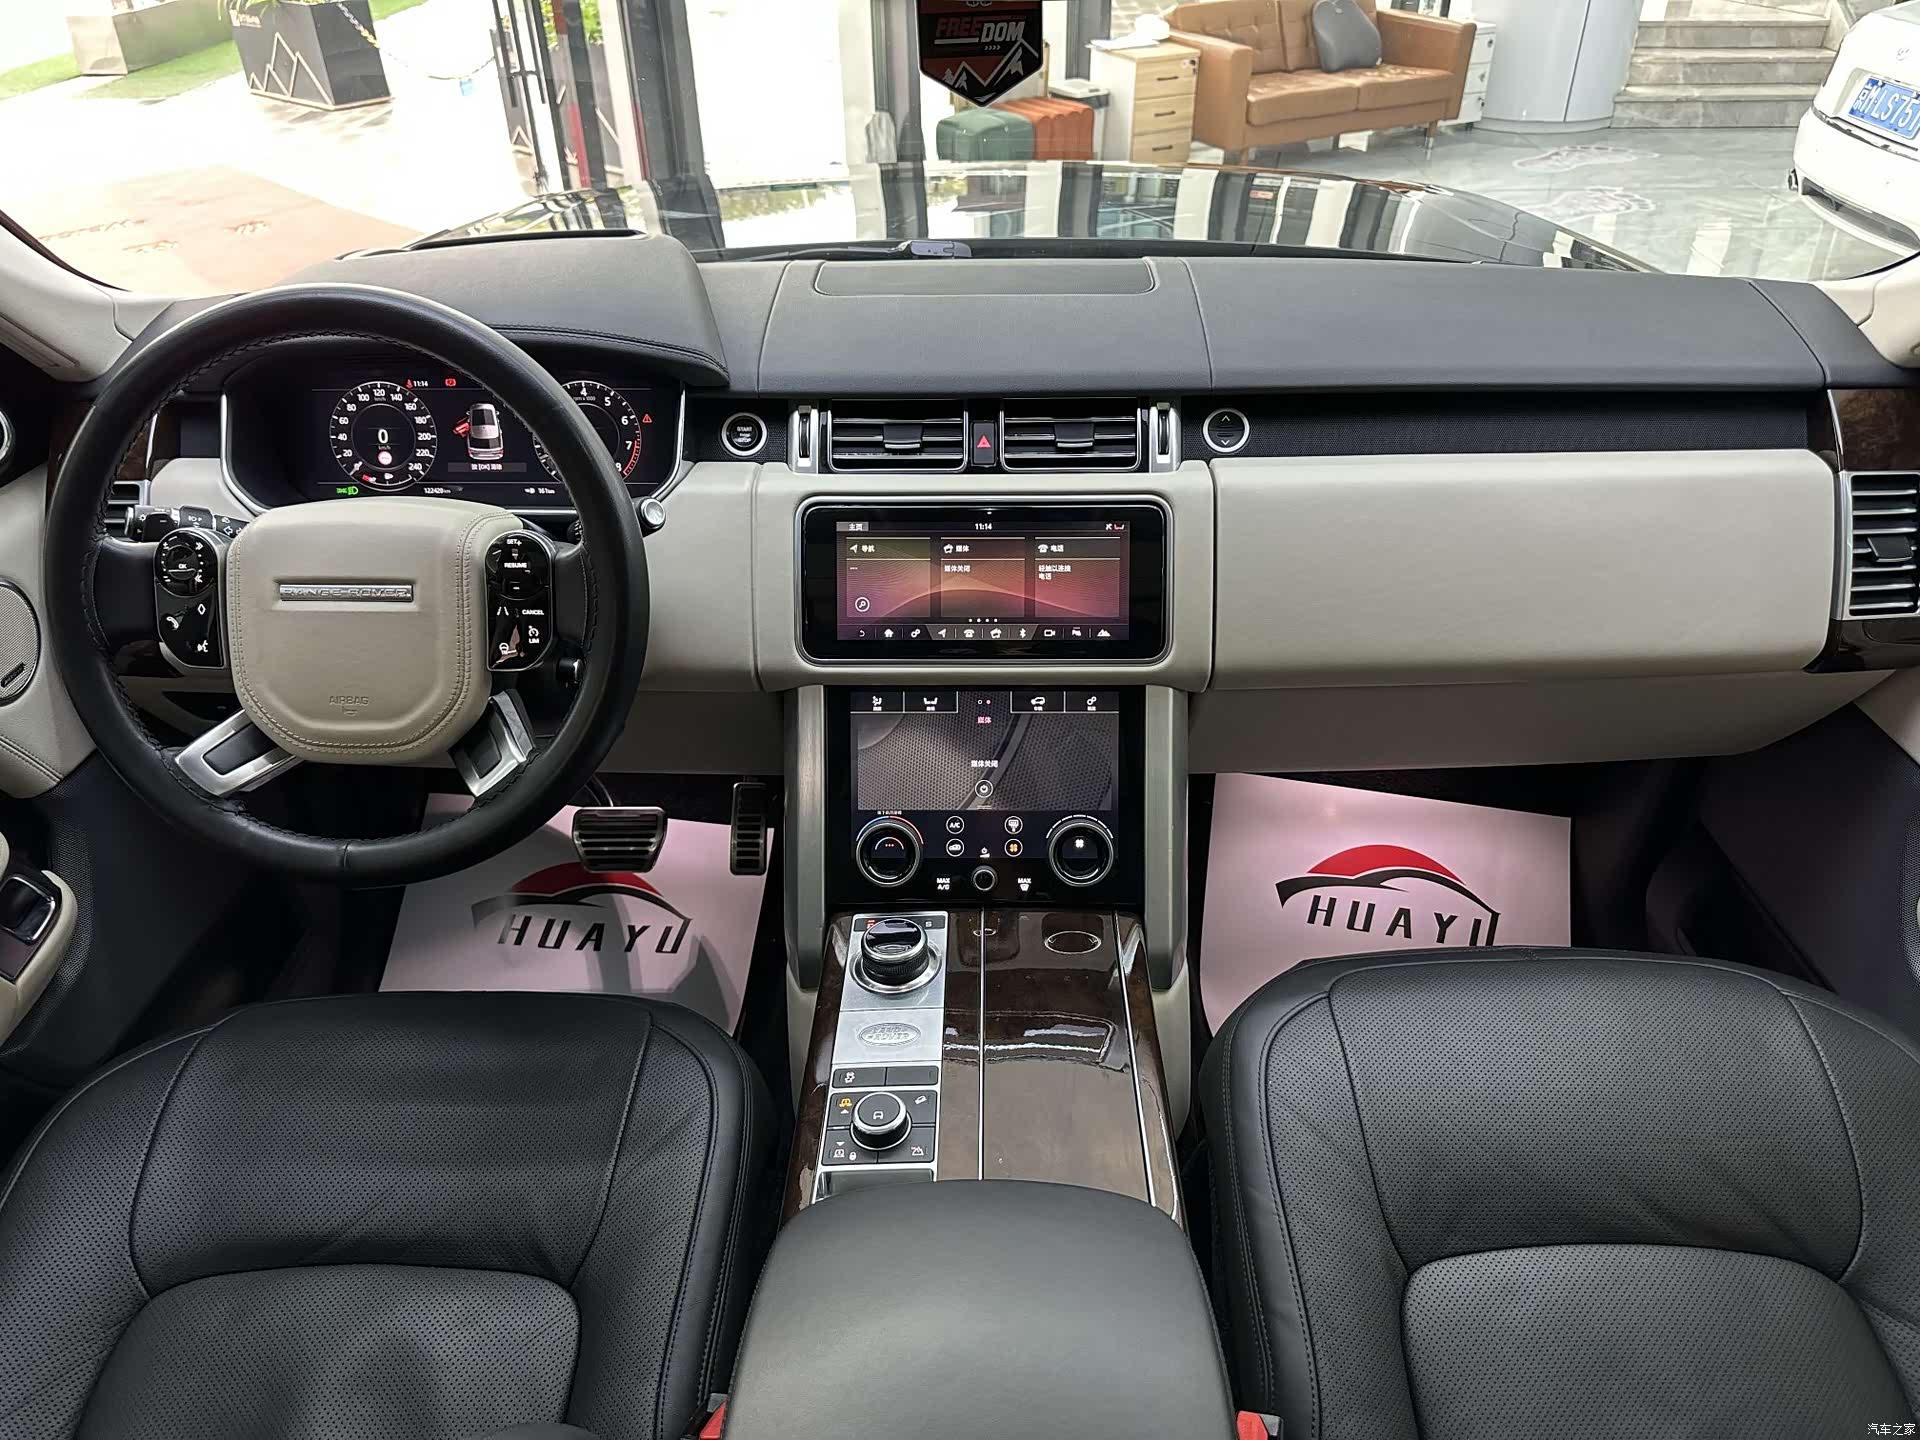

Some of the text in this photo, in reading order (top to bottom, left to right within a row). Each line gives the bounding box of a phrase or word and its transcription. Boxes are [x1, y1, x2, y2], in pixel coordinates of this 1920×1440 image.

[373, 389, 386, 397] 120
[580, 387, 588, 396] 4
[357, 394, 370, 402] 100
[390, 394, 403, 402] 140
[604, 397, 611, 406] 5
[404, 403, 417, 411] 160
[338, 417, 349, 425] 60
[414, 416, 427, 424] 180
[621, 416, 629, 425] 6
[337, 433, 348, 441] 40
[377, 429, 389, 444] 0
[417, 433, 431, 441] 200
[625, 441, 632, 450] 7
[342, 449, 353, 457] 20
[416, 449, 429, 457] 220
[408, 463, 422, 471] 240
[849, 523, 863, 531] 主页
[974, 523, 993, 531] 11:14
[861, 545, 875, 553] 导航
[955, 545, 970, 553] 媒体
[1050, 544, 1064, 552] 电话
[944, 565, 971, 573] 媒体关闭
[1038, 572, 1052, 580] 电话
[328, 695, 369, 705] AIRBAG
[971, 759, 999, 768] 媒体关闭
[497, 914, 692, 954] HUAYU
